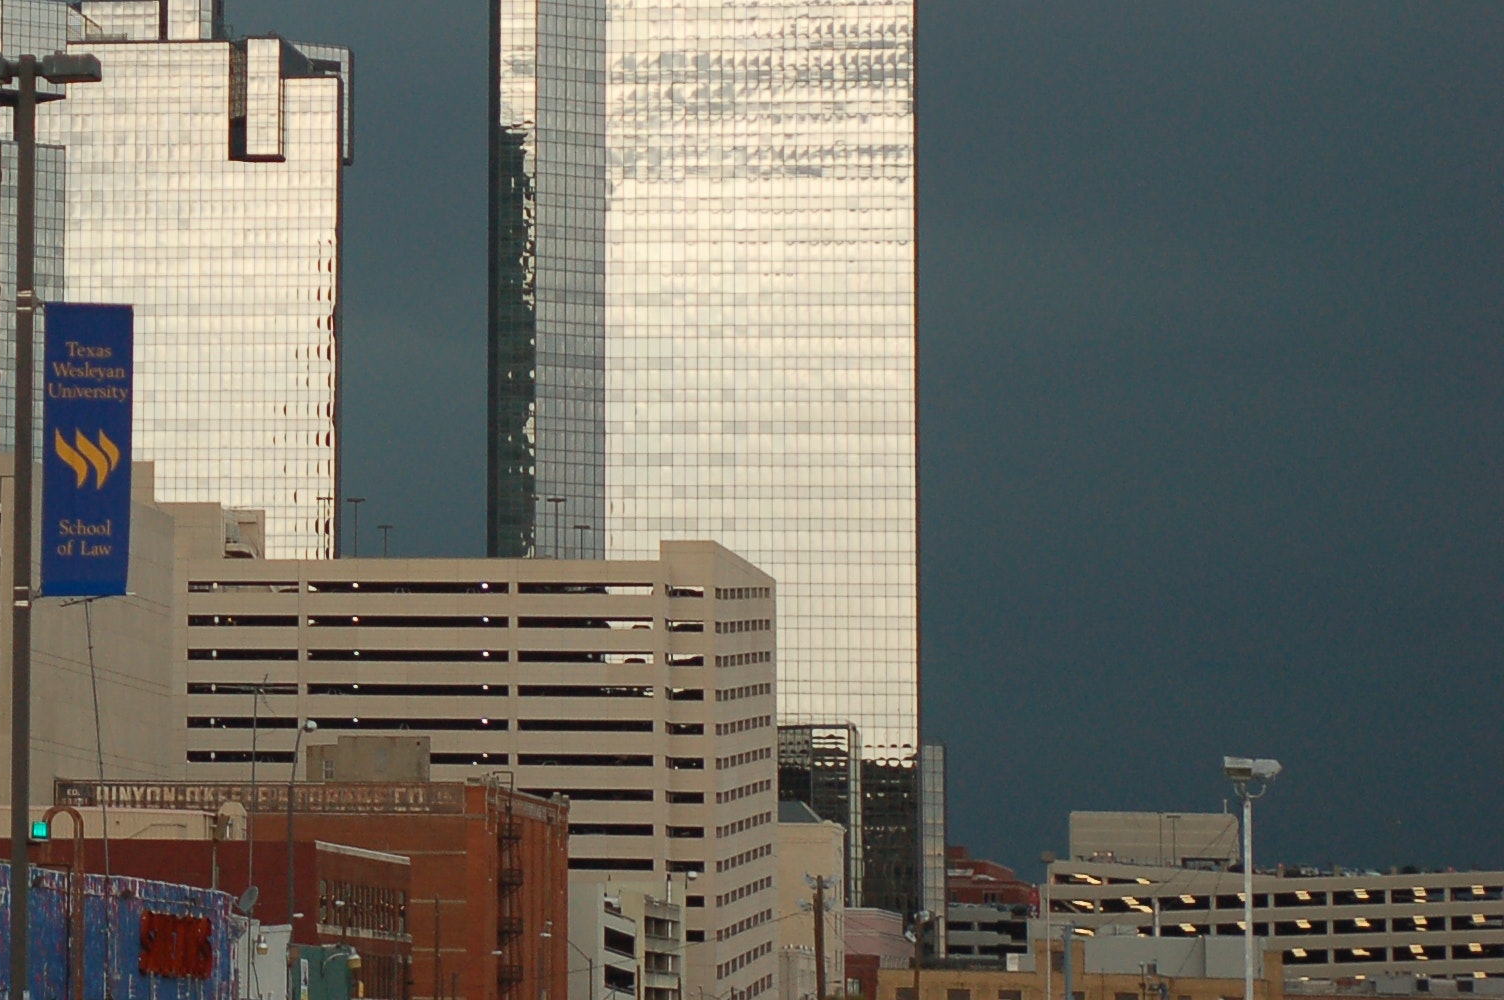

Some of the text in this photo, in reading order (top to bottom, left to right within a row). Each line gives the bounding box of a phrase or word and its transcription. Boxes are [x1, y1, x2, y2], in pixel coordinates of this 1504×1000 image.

[65, 341, 112, 358] Texas
[52, 361, 126, 382] Wesleyan
[48, 382, 128, 403] University
[59, 519, 112, 537] School
[57, 539, 112, 556] of Law
